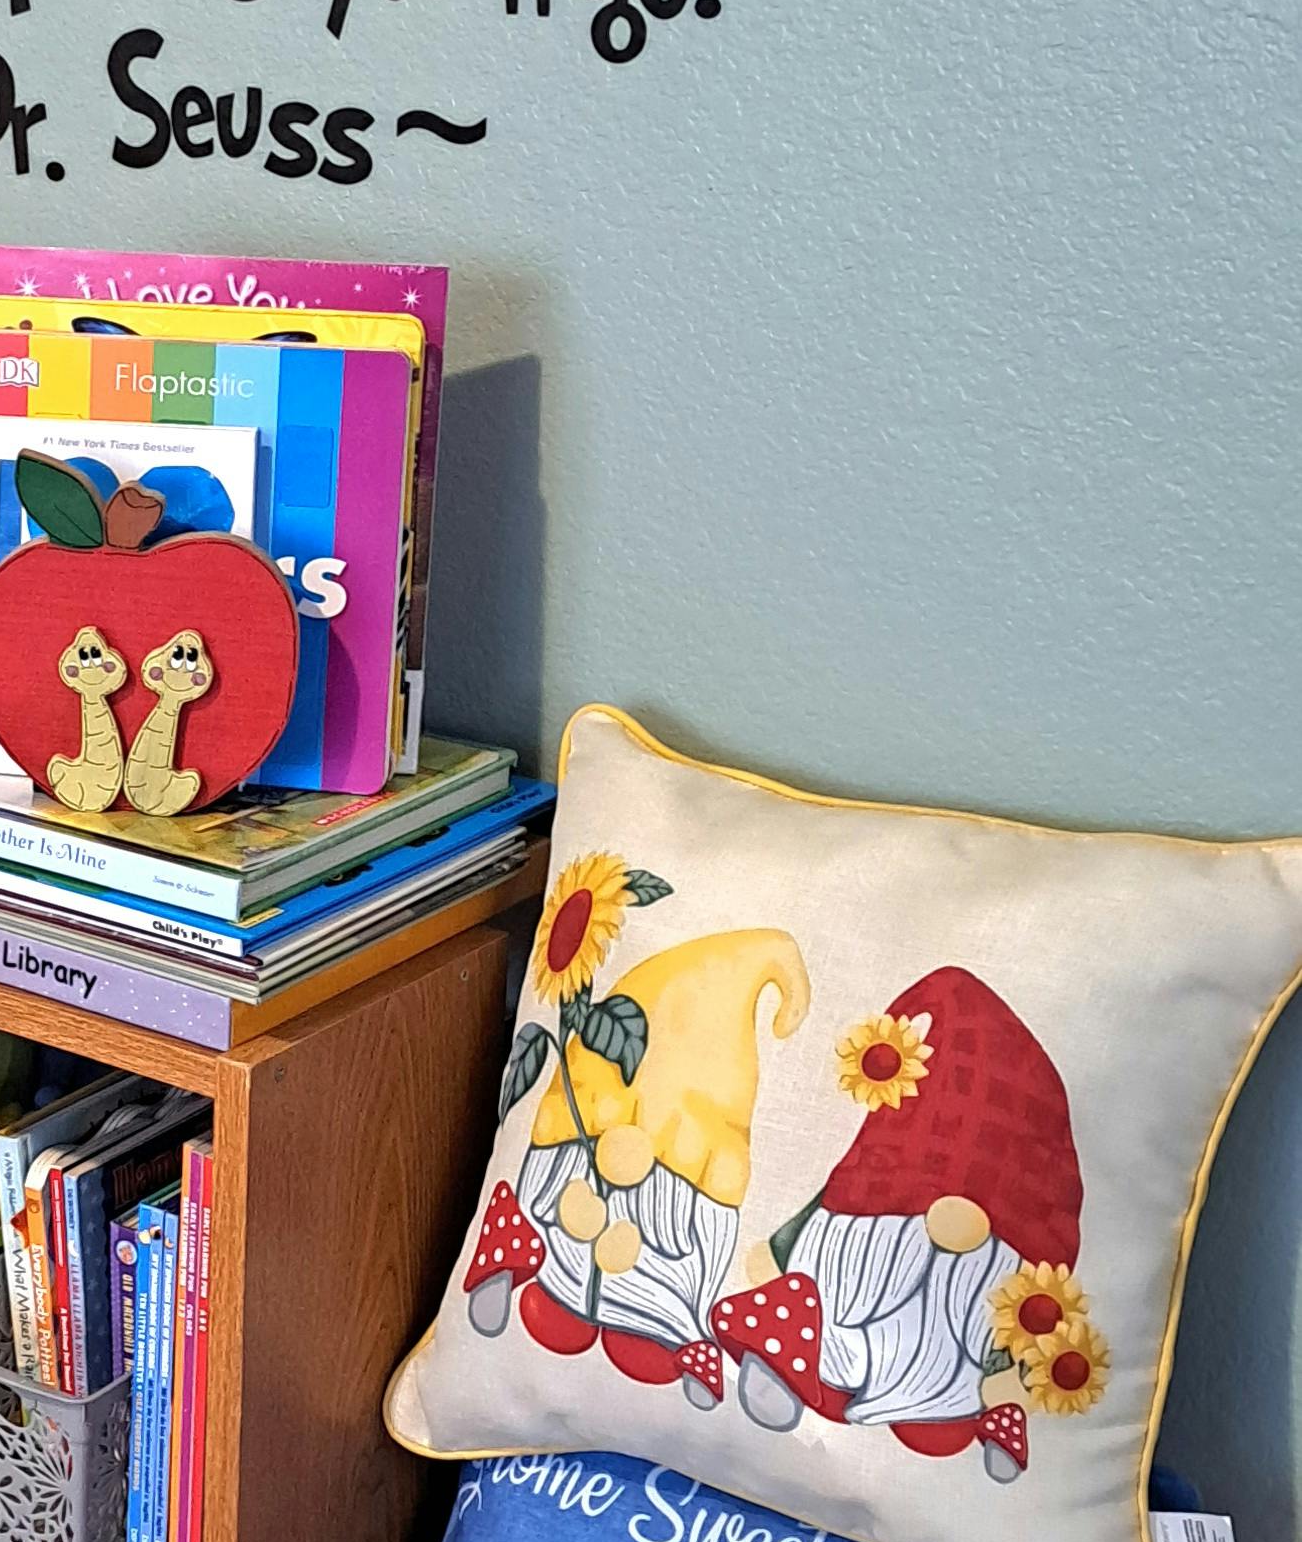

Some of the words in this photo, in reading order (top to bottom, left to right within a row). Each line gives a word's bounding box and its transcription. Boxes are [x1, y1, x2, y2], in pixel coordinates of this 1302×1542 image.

[2, 359, 36, 381] DK
[115, 363, 255, 402] Flaptastic
[58, 437, 80, 447] New
[83, 438, 107, 449] York
[110, 439, 140, 450] Times
[143, 442, 195, 453] Bestseller
[40, 836, 55, 857] Is
[56, 842, 107, 871] Mine
[152, 919, 188, 939] Child's
[2, 940, 98, 998] Library
[189, 1202, 198, 1229] EARLY
[202, 1207, 211, 1235] EARLY
[187, 1230, 197, 1274] LEARNING
[200, 1236, 210, 1279] LEARNING
[13, 1249, 28, 1292] What
[31, 1243, 51, 1323] Everybody
[122, 1273, 133, 1293] OLD
[186, 1274, 195, 1292] FUN
[139, 1292, 148, 1309] TEN
[200, 1280, 209, 1298] FUN
[17, 1293, 33, 1341] Makes
[123, 1296, 135, 1353] MACDONALD
[138, 1310, 147, 1339] LITTLE
[185, 1303, 194, 1337] COLORS
[23, 1343, 33, 1351] a
[38, 1327, 56, 1386] Potties!
[136, 1340, 146, 1383] MONKEYS
